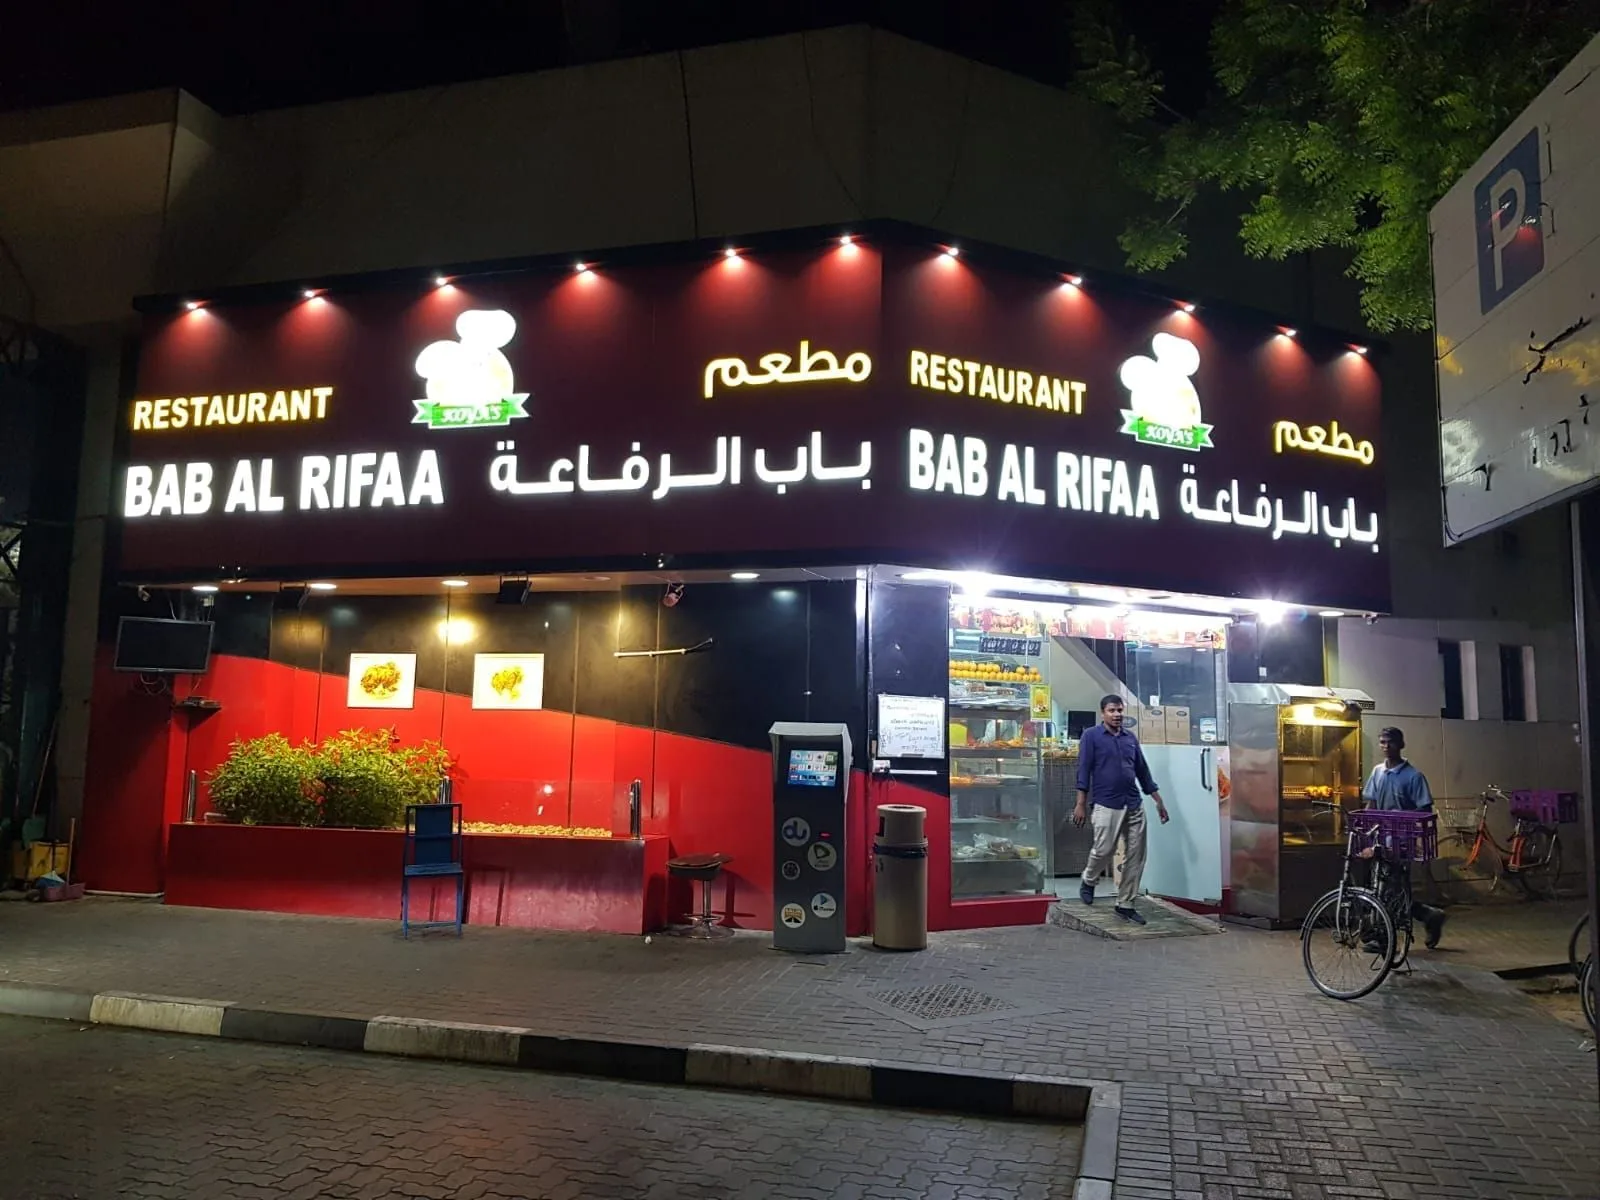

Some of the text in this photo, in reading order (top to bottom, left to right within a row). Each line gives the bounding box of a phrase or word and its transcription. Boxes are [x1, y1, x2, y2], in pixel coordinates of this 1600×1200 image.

[1489, 167, 1527, 291] P
[704, 340, 872, 399] مطعم
[910, 350, 1087, 415] RESTAURANT
[133, 386, 333, 430] RESTAURANT
[1275, 420, 1375, 465] مطعم
[123, 449, 445, 518] BAB AL RIFAA
[489, 431, 872, 500] باب الرفاعة
[908, 428, 1160, 520] BAB AL RIFAA
[1179, 463, 1379, 553] باب الرفاعة
